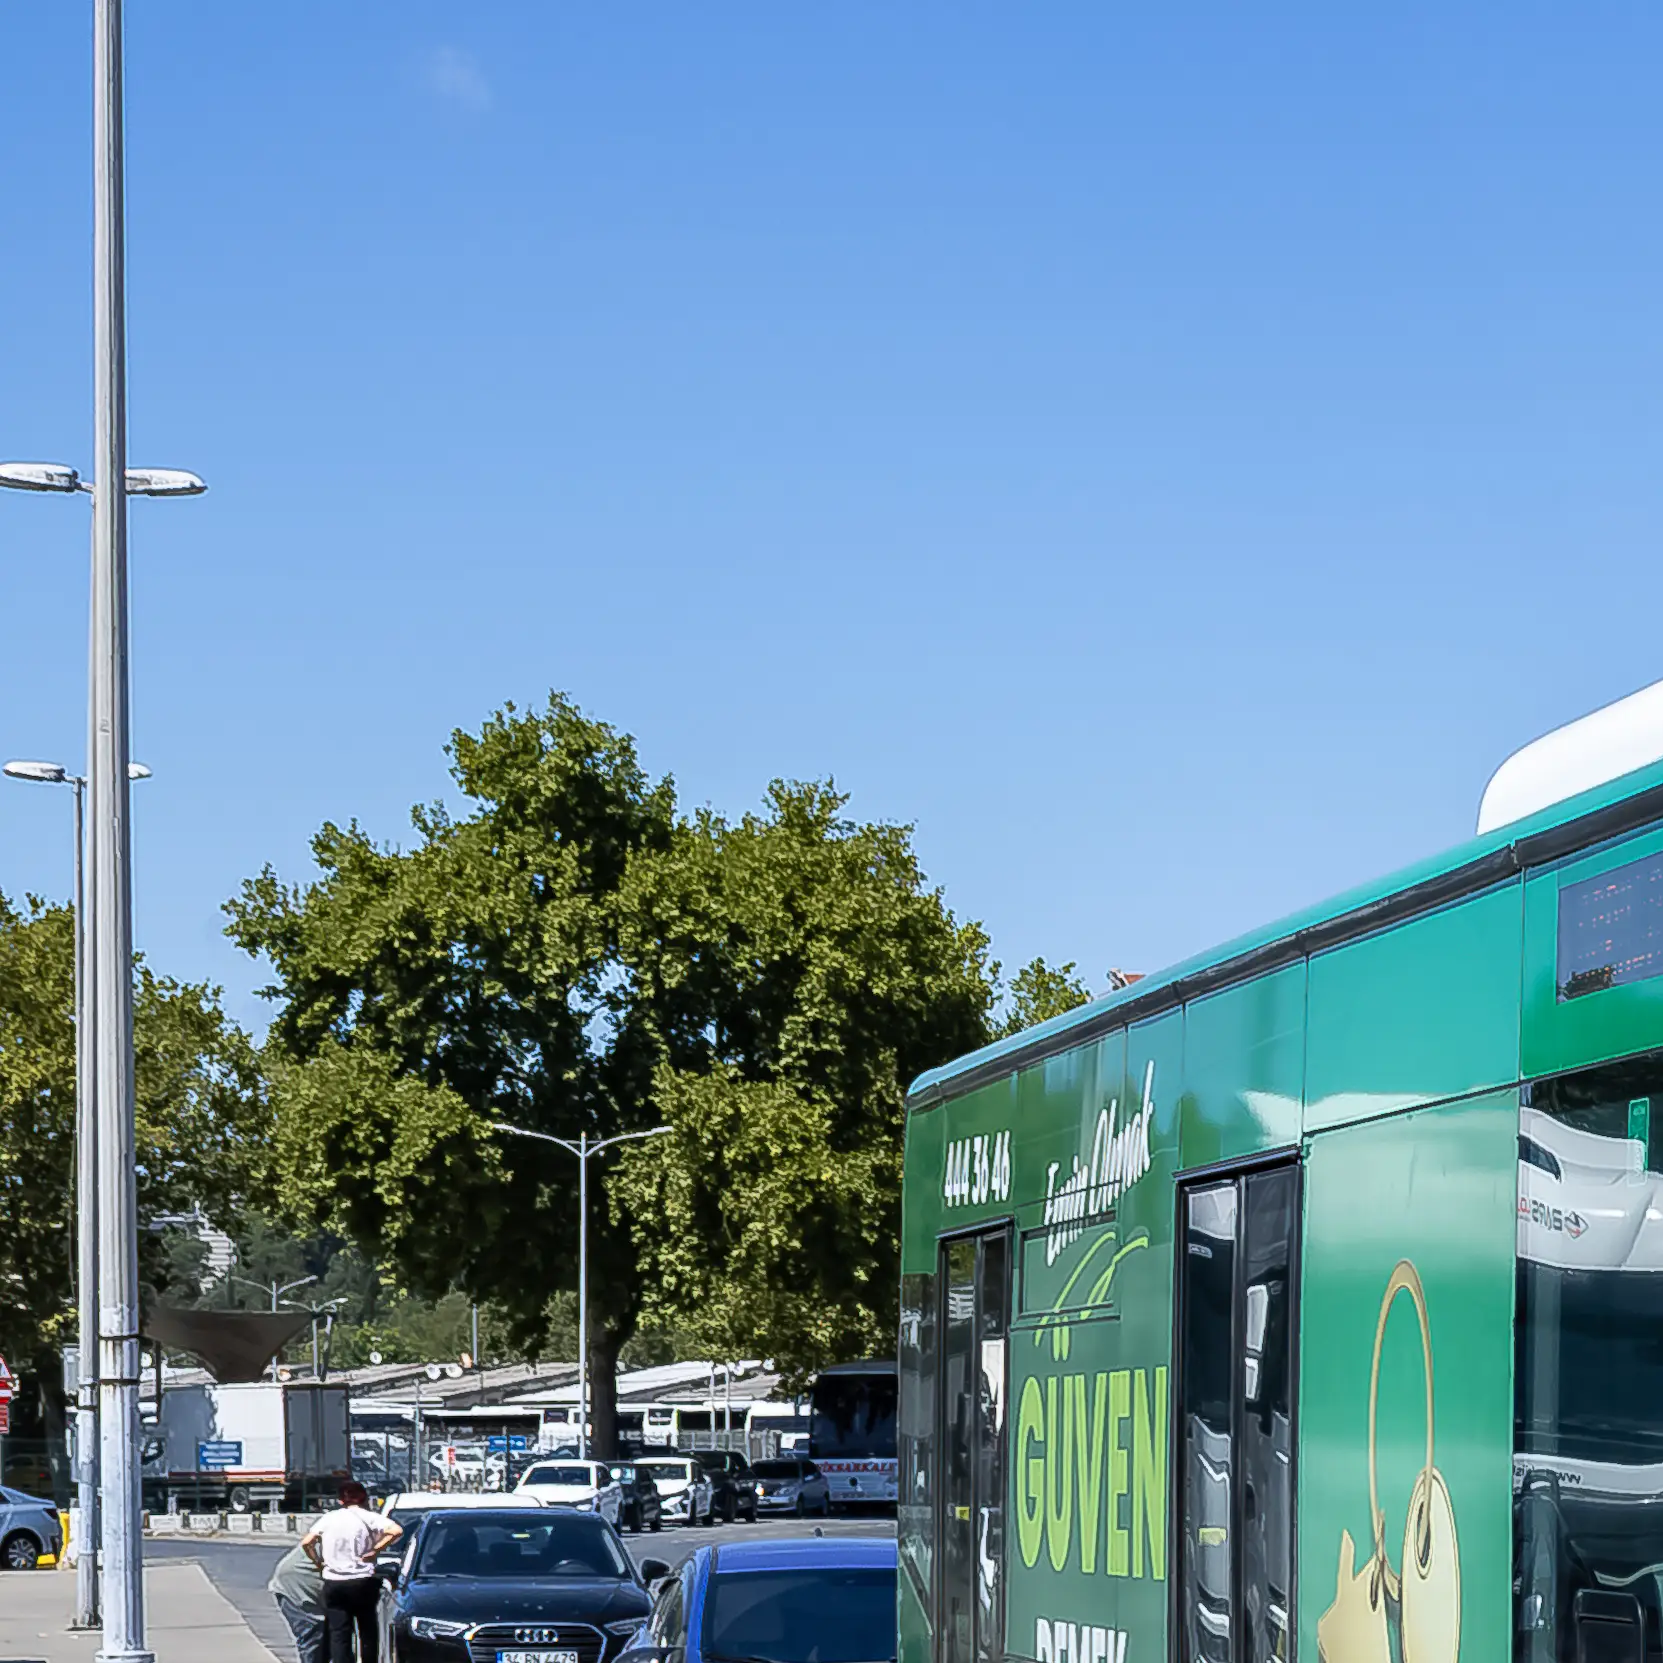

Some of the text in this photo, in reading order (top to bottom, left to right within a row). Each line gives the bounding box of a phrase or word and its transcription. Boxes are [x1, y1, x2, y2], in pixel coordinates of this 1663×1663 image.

[945, 1130, 1010, 1207] 444 36 46
[1016, 1318, 1168, 1581] GÜVEN
